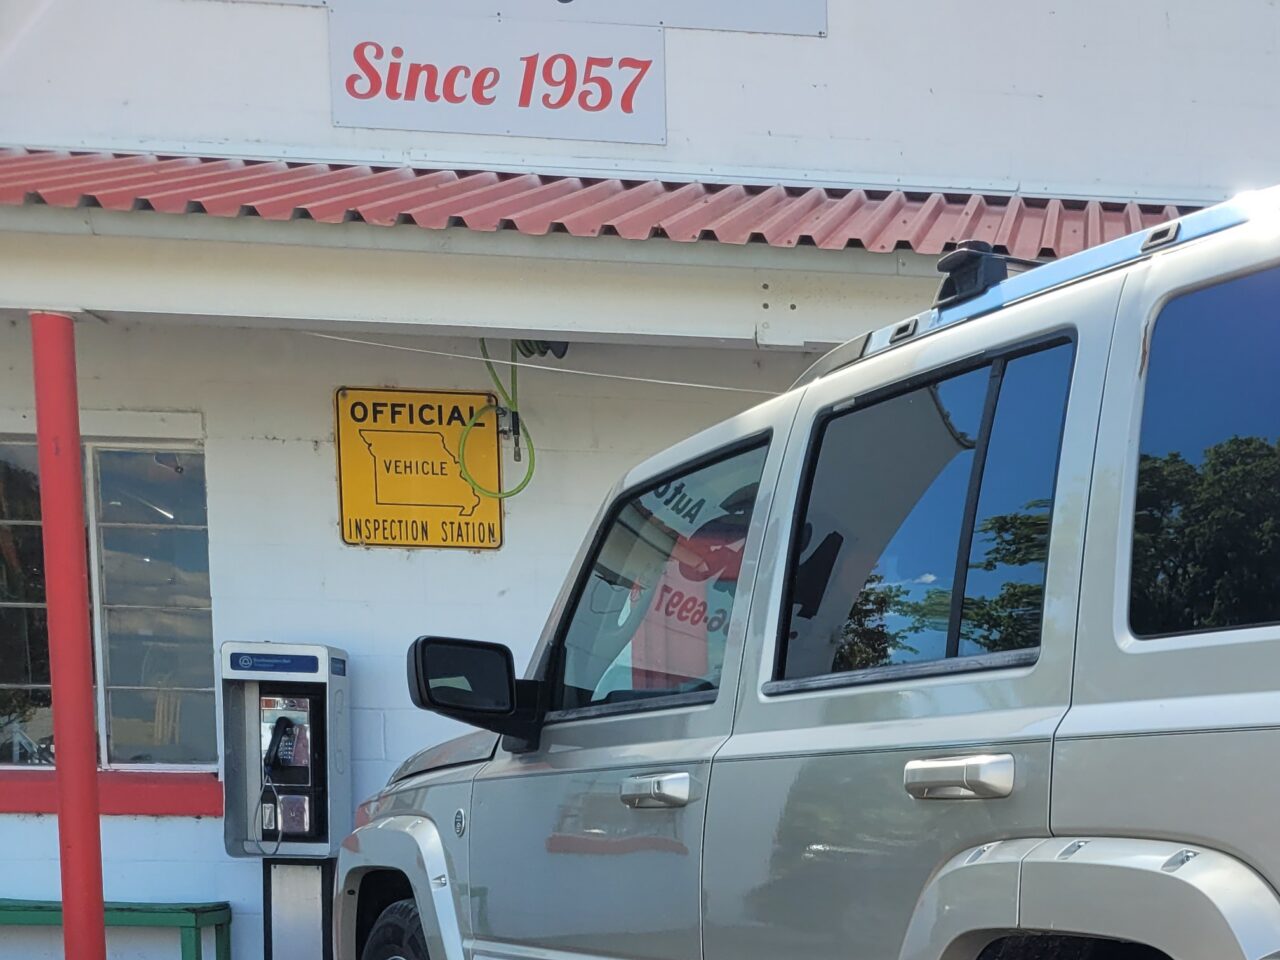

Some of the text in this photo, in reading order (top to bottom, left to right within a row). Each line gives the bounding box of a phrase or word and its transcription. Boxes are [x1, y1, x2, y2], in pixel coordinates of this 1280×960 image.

[345, 41, 653, 114] Since 1957
[350, 401, 486, 428] OFFICIAL
[383, 459, 449, 476] VEHICLE
[348, 518, 497, 544] INSPECTION STATION
